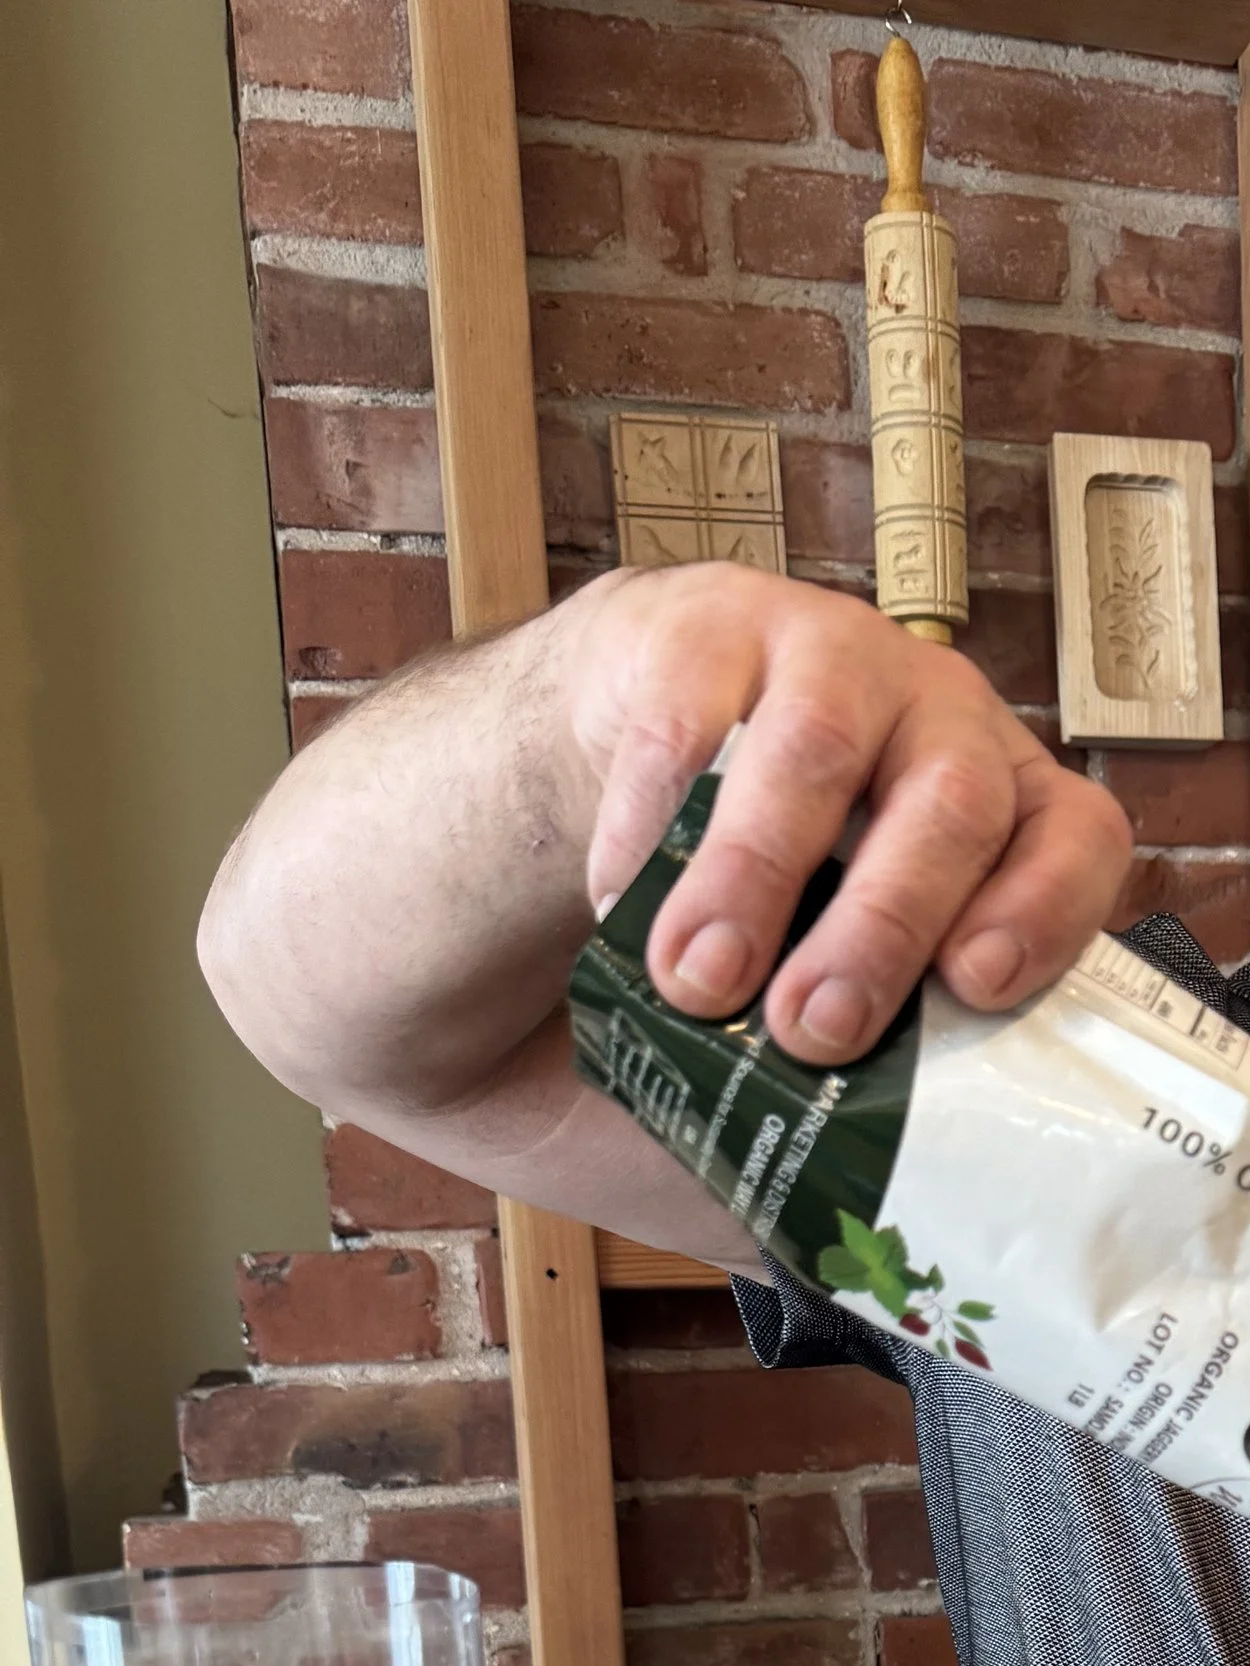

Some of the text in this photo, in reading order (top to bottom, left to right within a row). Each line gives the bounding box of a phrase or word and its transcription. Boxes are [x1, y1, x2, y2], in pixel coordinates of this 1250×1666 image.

[741, 1114, 786, 1186] ORGANIC
[776, 1074, 848, 1185] MARKETING
[1140, 1106, 1233, 1177] 100%
[1146, 1312, 1179, 1356] LOT
[1175, 1331, 1240, 1422] ORGANIC
